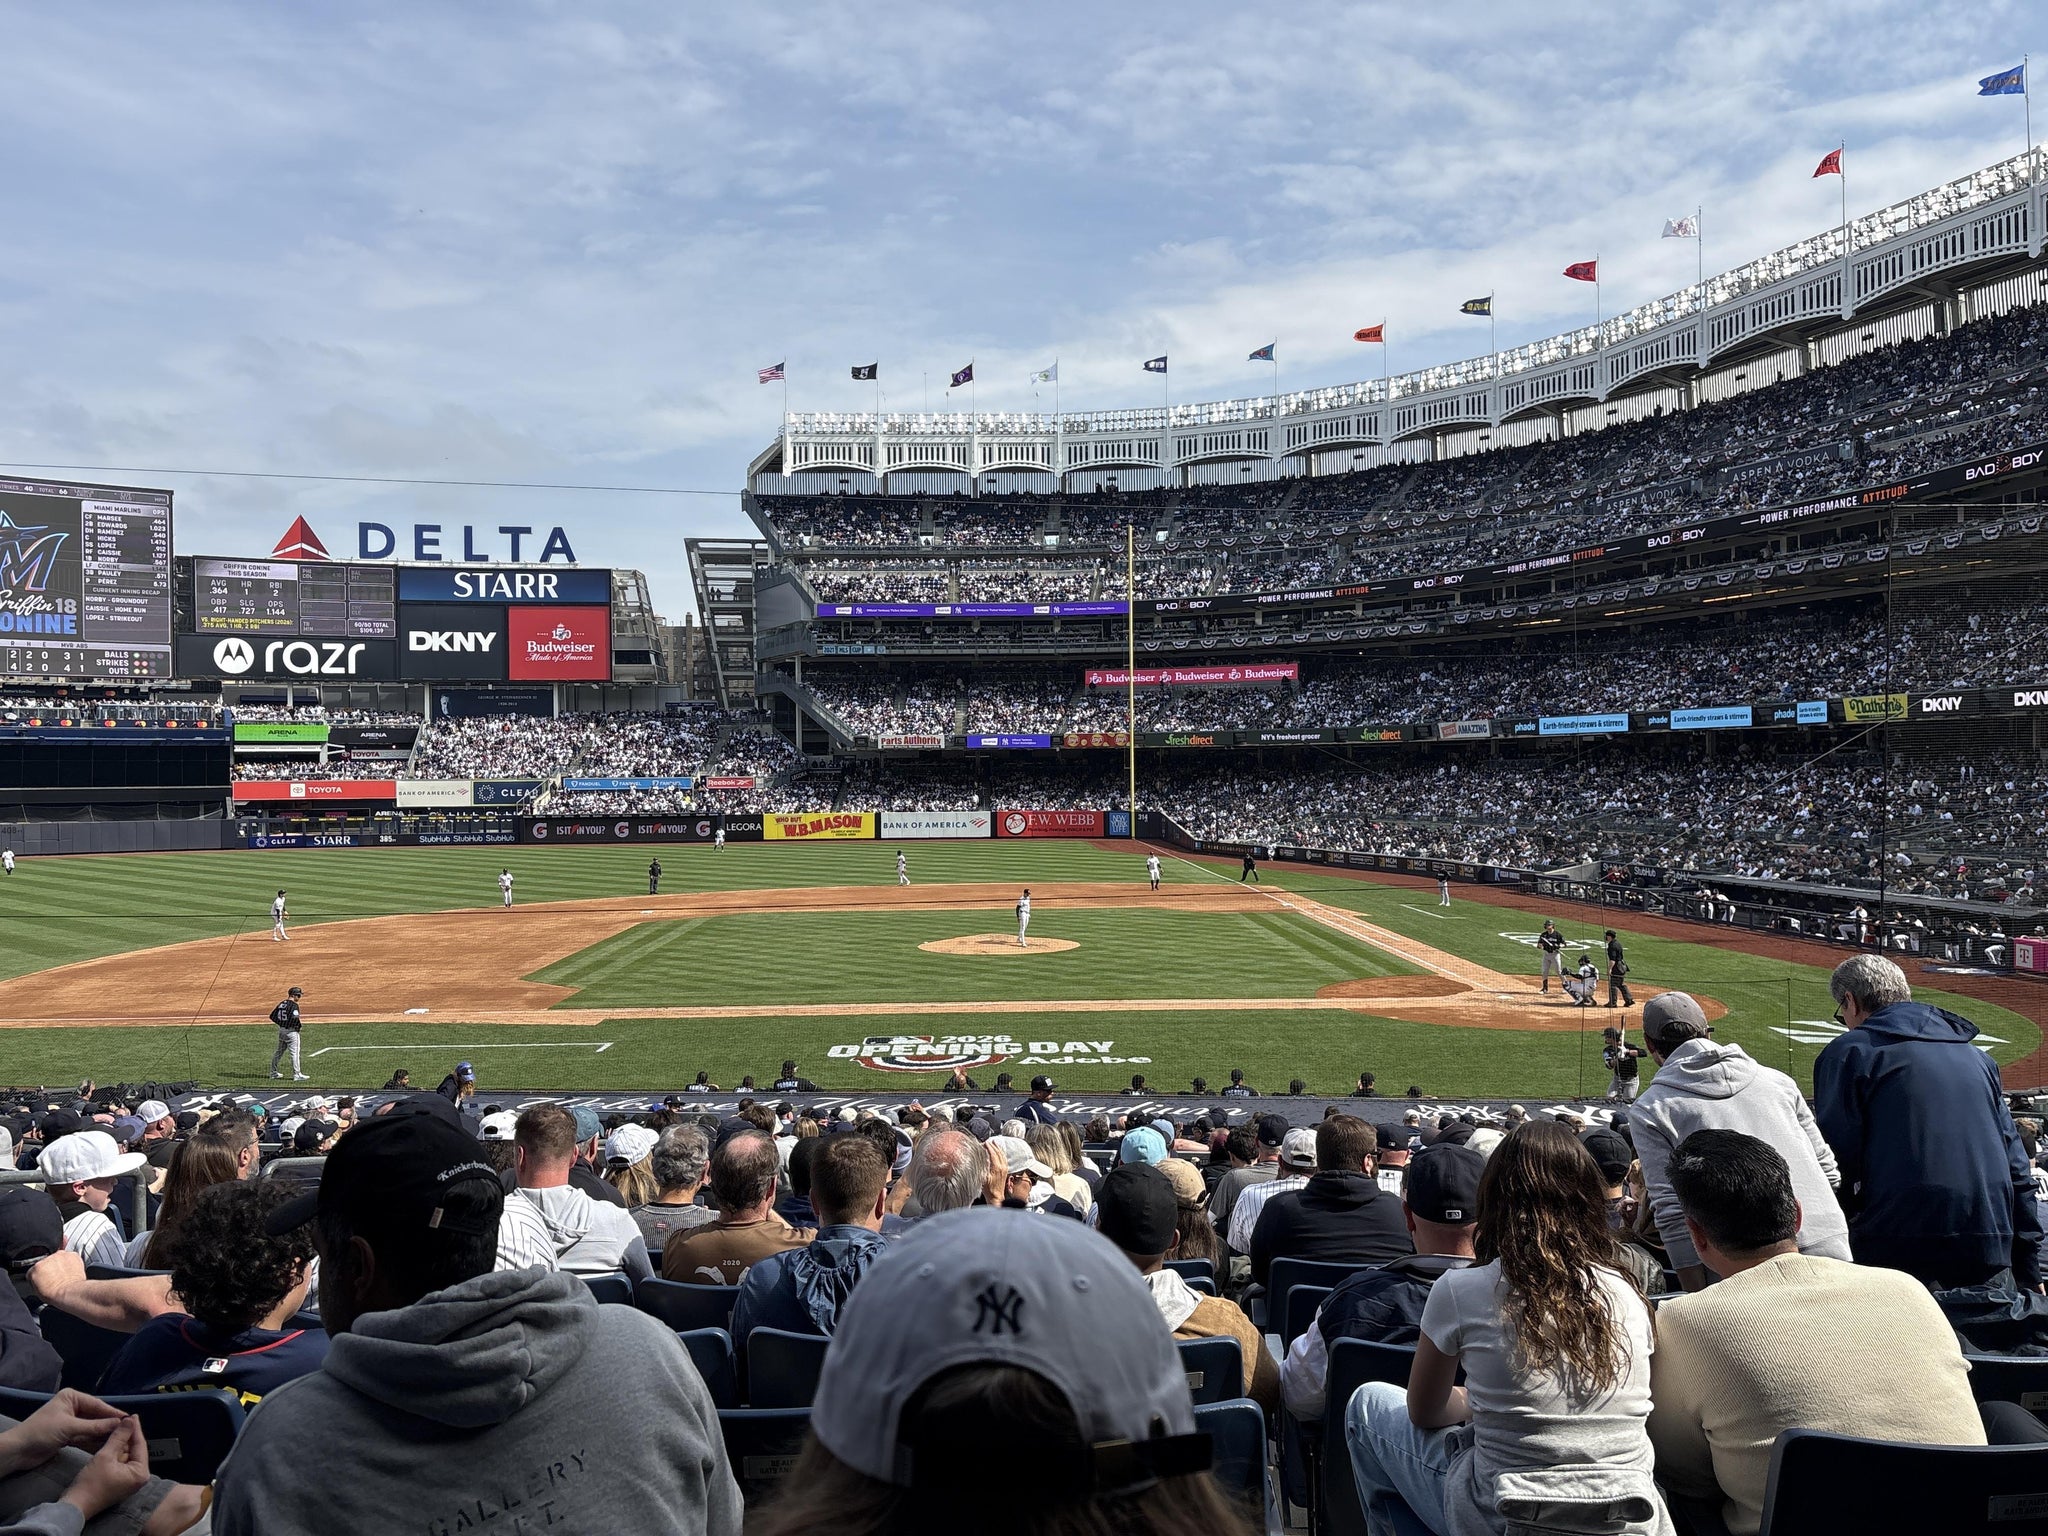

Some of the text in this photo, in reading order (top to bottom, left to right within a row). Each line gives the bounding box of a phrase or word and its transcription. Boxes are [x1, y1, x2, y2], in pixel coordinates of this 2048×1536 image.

[1733, 451, 1830, 482] ASPEN VODKA
[1965, 450, 2044, 480] BAD BOY
[1606, 497, 1638, 511] ASPEN
[1760, 484, 1908, 523] POWER. PERFORMANCE. ATTITUDE
[97, 521, 128, 529] EDWARDS
[358, 522, 578, 563] DELTA
[1647, 527, 1706, 548] BAD BOY
[1507, 563, 1528, 574] POWER.
[1573, 547, 1604, 561] ATTITUDE
[223, 563, 247, 571] GRIFFIN
[210, 579, 227, 587] AVG
[241, 580, 252, 588] HR
[269, 581, 283, 589] RBI
[453, 572, 559, 599] STARR
[1413, 574, 1464, 589] BAD BOY
[209, 587, 228, 595] .364
[273, 589, 279, 597] 2
[1335, 586, 1369, 596] ATTITUDE
[55, 597, 77, 614] 18
[210, 598, 227, 606] OBP
[239, 599, 254, 607] SLG
[267, 600, 284, 608] OPS
[1156, 600, 1212, 611] BAD BOY
[211, 606, 227, 614] .417
[238, 607, 256, 615] .727
[266, 608, 286, 616] 1.144
[408, 631, 497, 652] DKNY
[526, 640, 596, 653] Budweiser
[10, 650, 84, 660] 2 2 0 3 1
[264, 641, 366, 675] razr
[525, 653, 593, 663] Made of America
[10, 662, 71, 672] 4 2 0 4
[96, 659, 129, 667] STRIKES
[108, 667, 129, 675] OUTS
[1106, 668, 1294, 683] Budweiser Budweiser Budweiser
[1850, 698, 1904, 715] Nathan's
[1922, 696, 1962, 712] DKNY
[1648, 715, 1668, 725] phade
[1674, 715, 1706, 723] Earth-friendly
[1774, 709, 1795, 721] phade
[1458, 723, 1487, 734] AMAZING
[1515, 719, 1624, 733] phade Earth-friendly straws stirrers
[880, 735, 941, 745] Parts Authority
[1165, 734, 1213, 746] freshdirect
[1261, 732, 1320, 741] NY's freshest grocer
[1361, 728, 1401, 742] freshdirect
[501, 788, 539, 797] CLEAR
[925, 821, 967, 829] AMERICA
[1028, 814, 1052, 825] F.W.
[1054, 814, 1095, 826] WEBB
[557, 825, 564, 835] IS
[565, 825, 571, 835] IT
[585, 825, 606, 835] YOU?
[638, 824, 645, 834] IS
[646, 824, 653, 834] IT
[667, 824, 687, 834] YOU?
[726, 822, 763, 831] LEGORA
[313, 835, 351, 846] STARR
[419, 834, 515, 843] StubHub StubHub StubHub
[1634, 866, 1656, 877] StubHub
[940, 1035, 1012, 1044] 2026
[827, 1041, 1115, 1058] OPENING DAY
[1017, 1055, 1153, 1065] Adobe
[1050, 1098, 1249, 1117] Stadium
[972, 1282, 1025, 1335] NY
